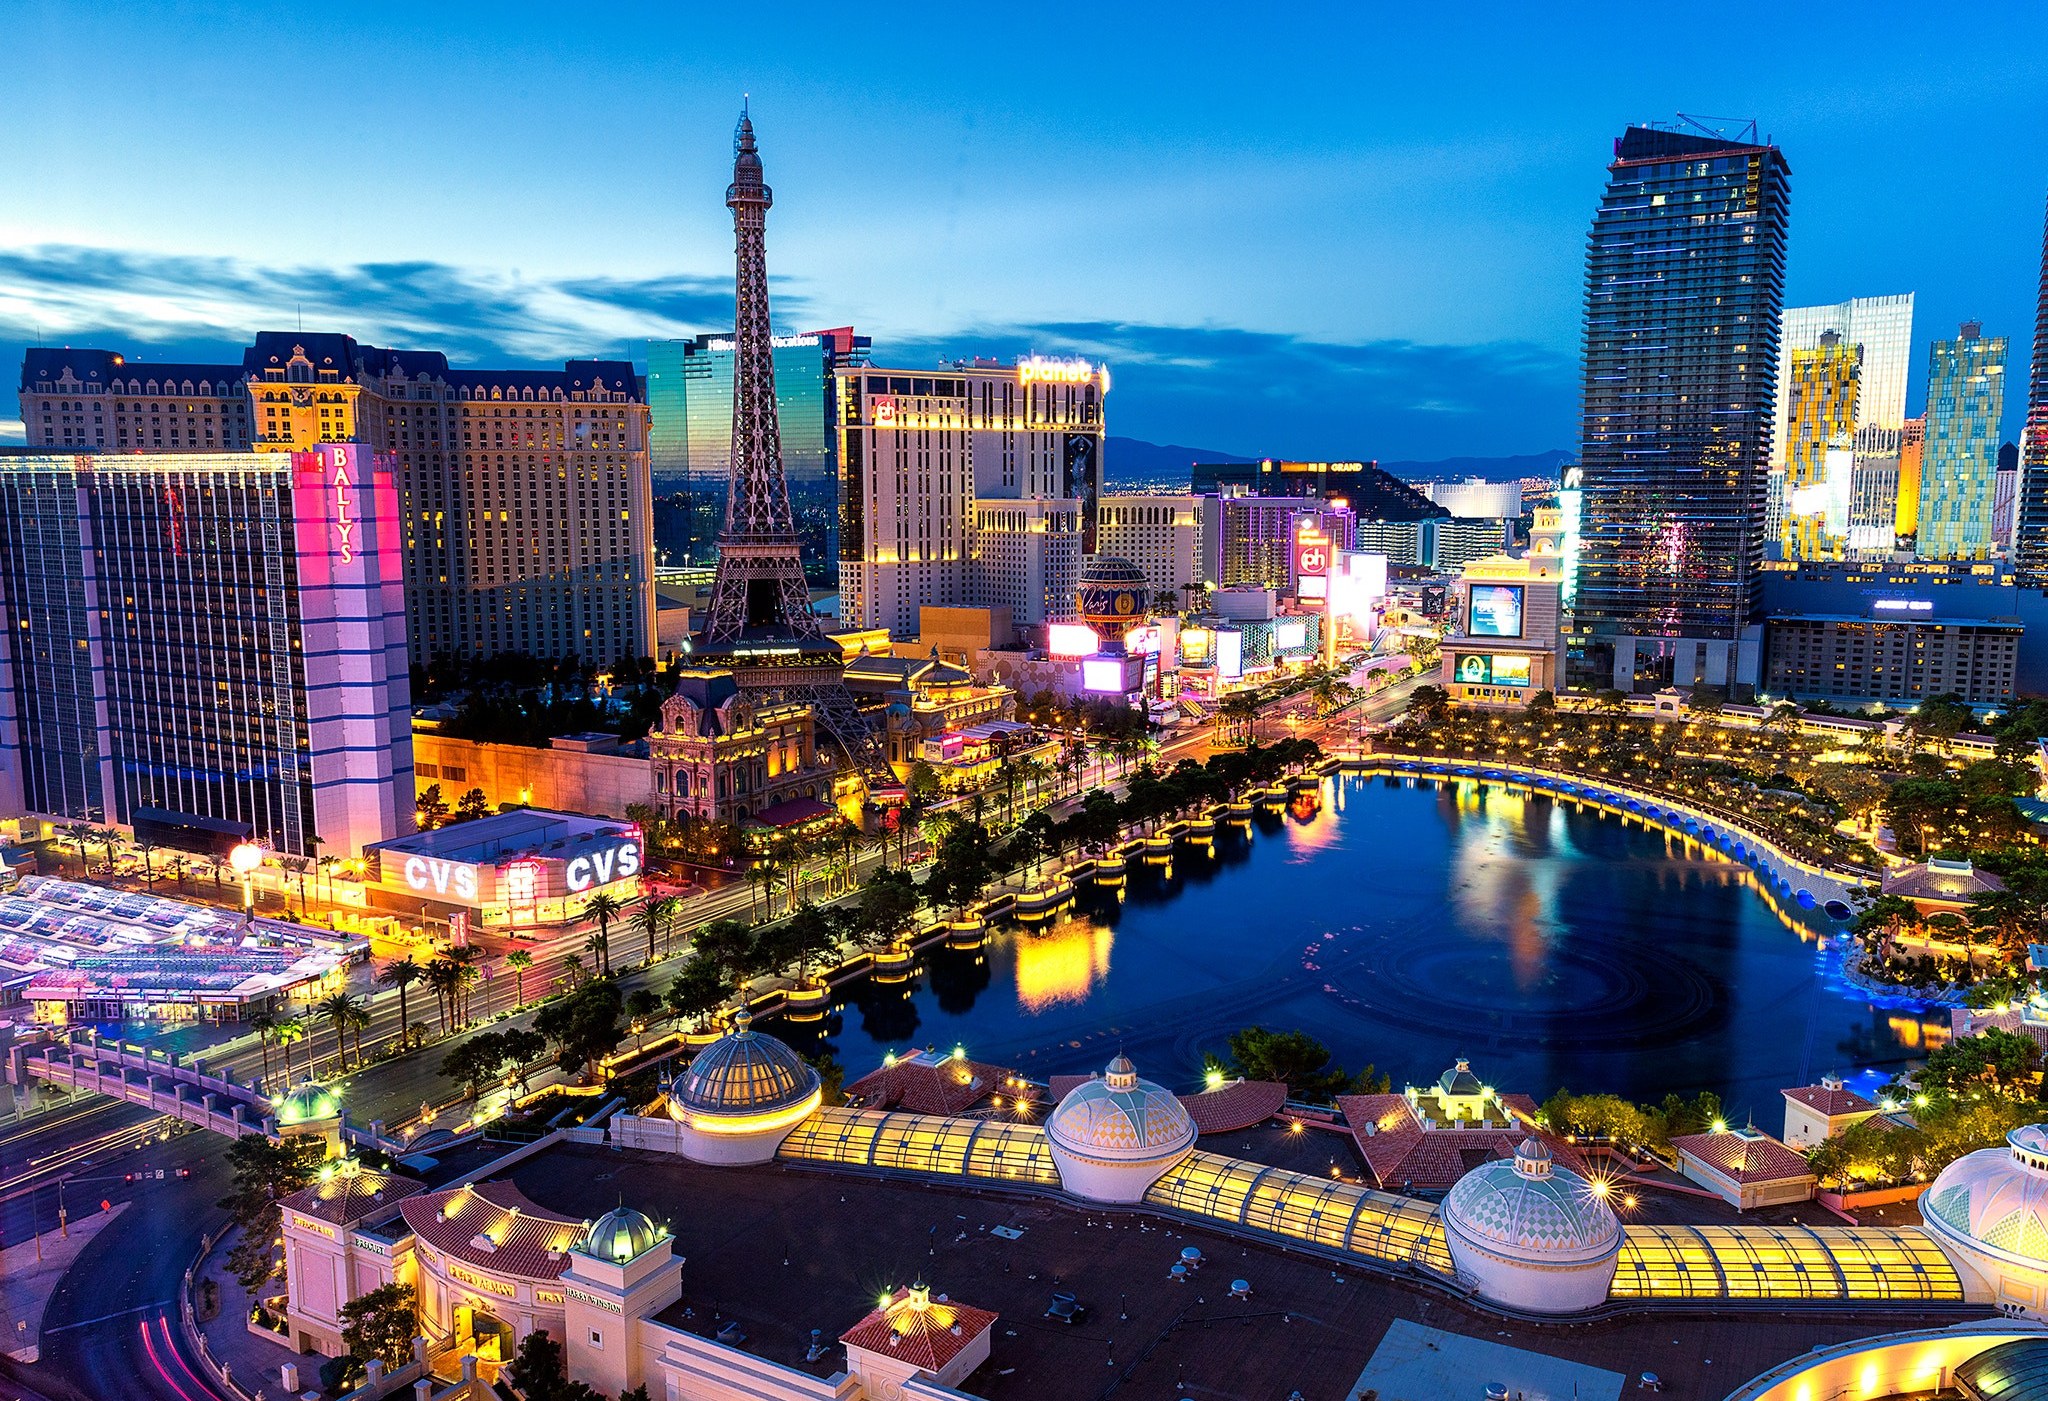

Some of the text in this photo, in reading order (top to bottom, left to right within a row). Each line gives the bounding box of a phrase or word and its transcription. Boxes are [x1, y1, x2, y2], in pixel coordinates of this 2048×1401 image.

[770, 334, 820, 348] Vacations
[1019, 356, 1091, 386] planet
[1331, 463, 1362, 472] GRAND
[332, 447, 354, 564] BALLYS
[1082, 585, 1108, 612] Paris
[405, 856, 477, 899] CVS
[567, 843, 639, 891] CVS
[478, 1277, 515, 1297] ARMANI
[565, 1286, 623, 1315] HARRY WINSTON
